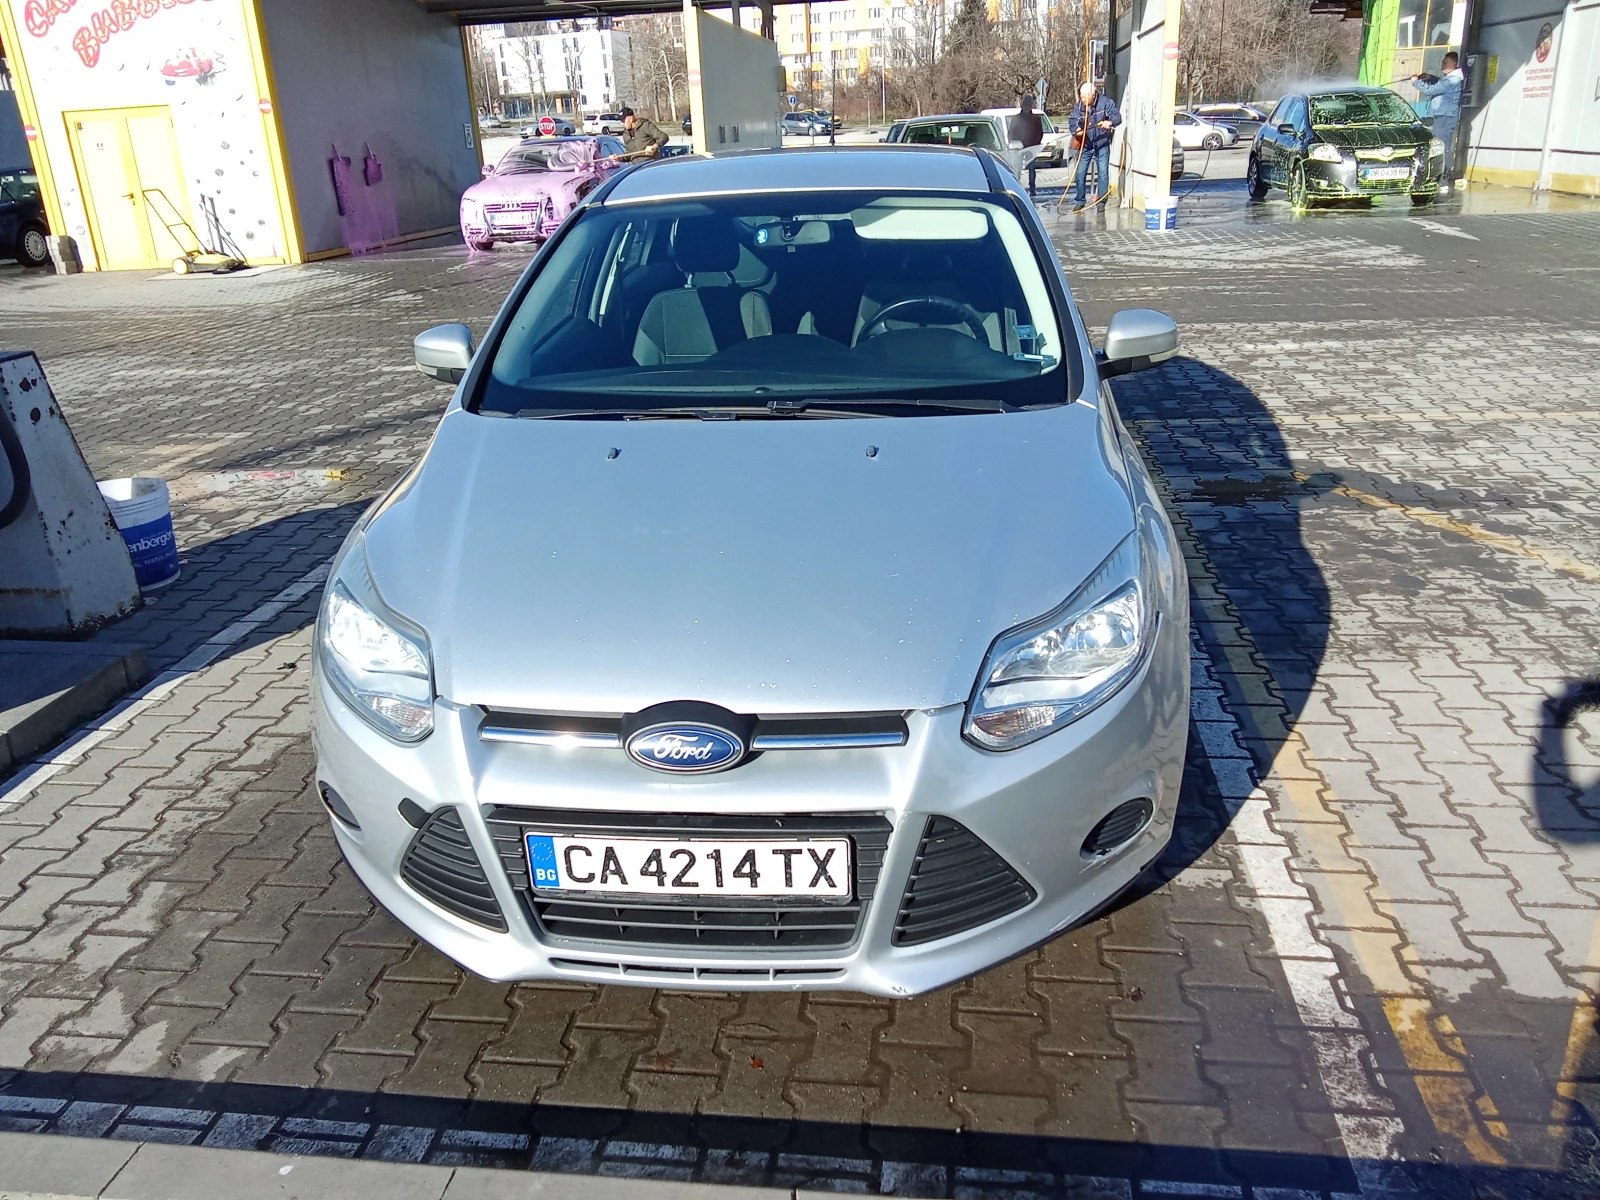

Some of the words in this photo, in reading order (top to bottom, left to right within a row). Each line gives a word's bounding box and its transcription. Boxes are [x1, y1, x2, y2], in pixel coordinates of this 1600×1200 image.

[540, 122, 554, 130] STOP
[654, 734, 714, 760] Ford
[536, 869, 557, 881] BG
[563, 845, 629, 885] CA
[640, 848, 760, 888] 4214
[772, 848, 838, 888] TX
